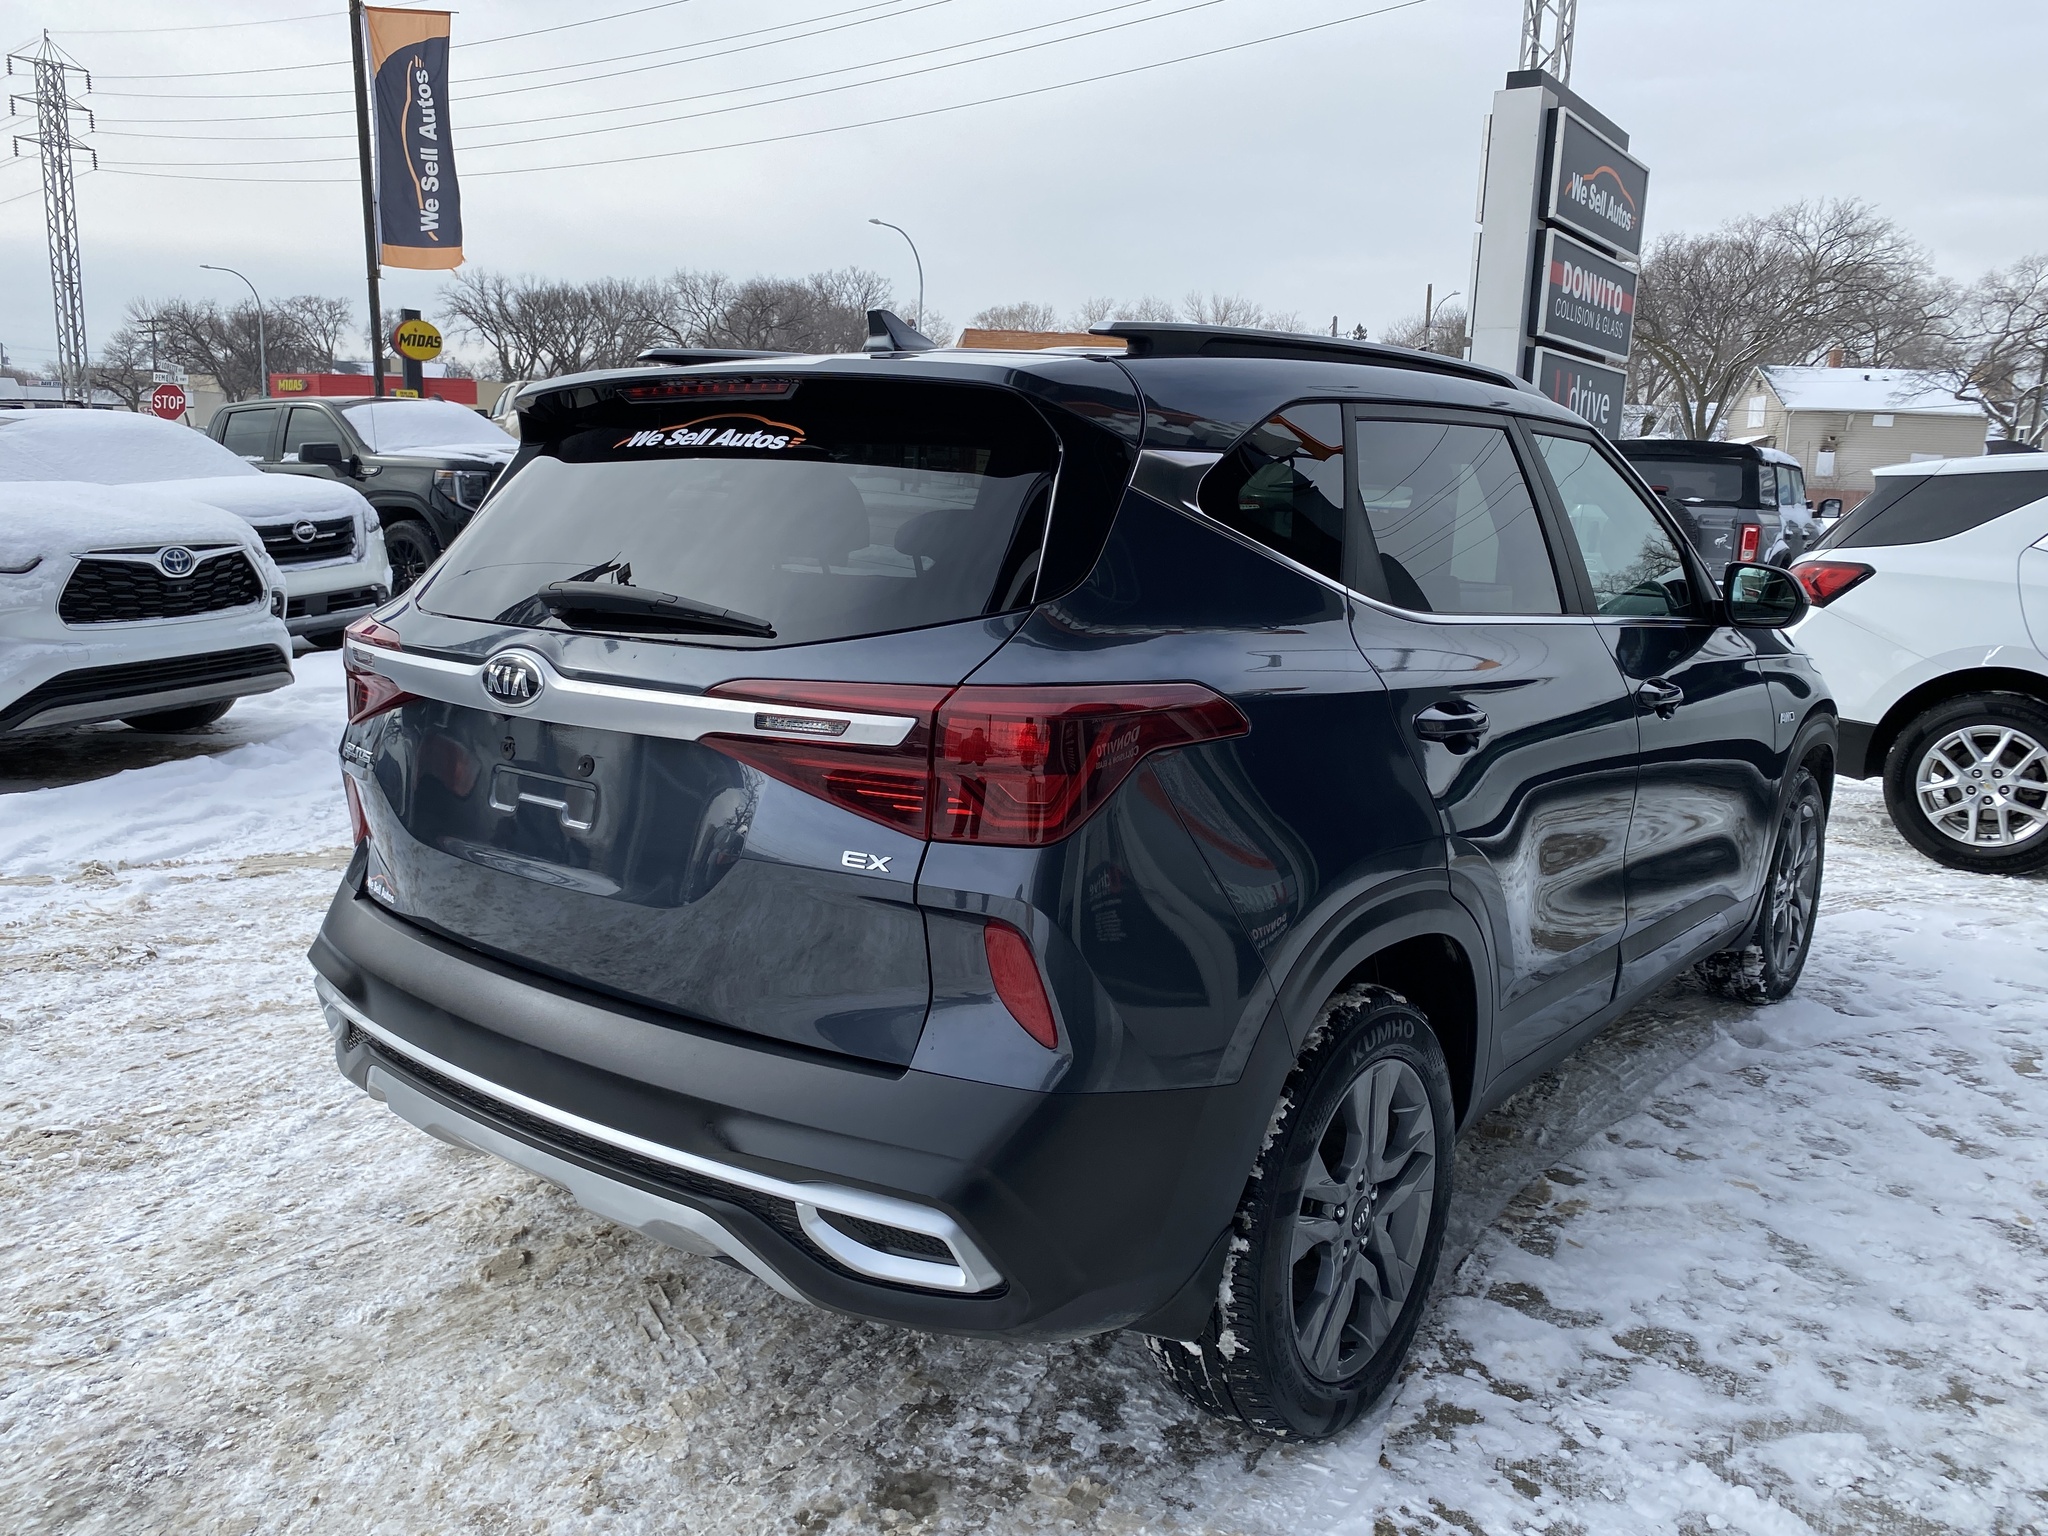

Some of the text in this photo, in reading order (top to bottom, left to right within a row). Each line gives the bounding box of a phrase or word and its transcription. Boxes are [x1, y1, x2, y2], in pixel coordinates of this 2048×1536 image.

[416, 69, 440, 232] We Sell Autos
[1571, 172, 1632, 232] We Sell Autos
[1562, 260, 1623, 316] DONVITO
[1555, 298, 1624, 339] COLLISION & GLASS
[399, 332, 442, 349] MIDAS
[155, 373, 179, 383] PEMBNA
[278, 379, 303, 391] MIDAS
[154, 395, 184, 410] STOP
[627, 428, 790, 450] We Sell Autos
[488, 664, 530, 698] KIA
[841, 850, 893, 873] EX
[1350, 1020, 1415, 1067] KUMHO
